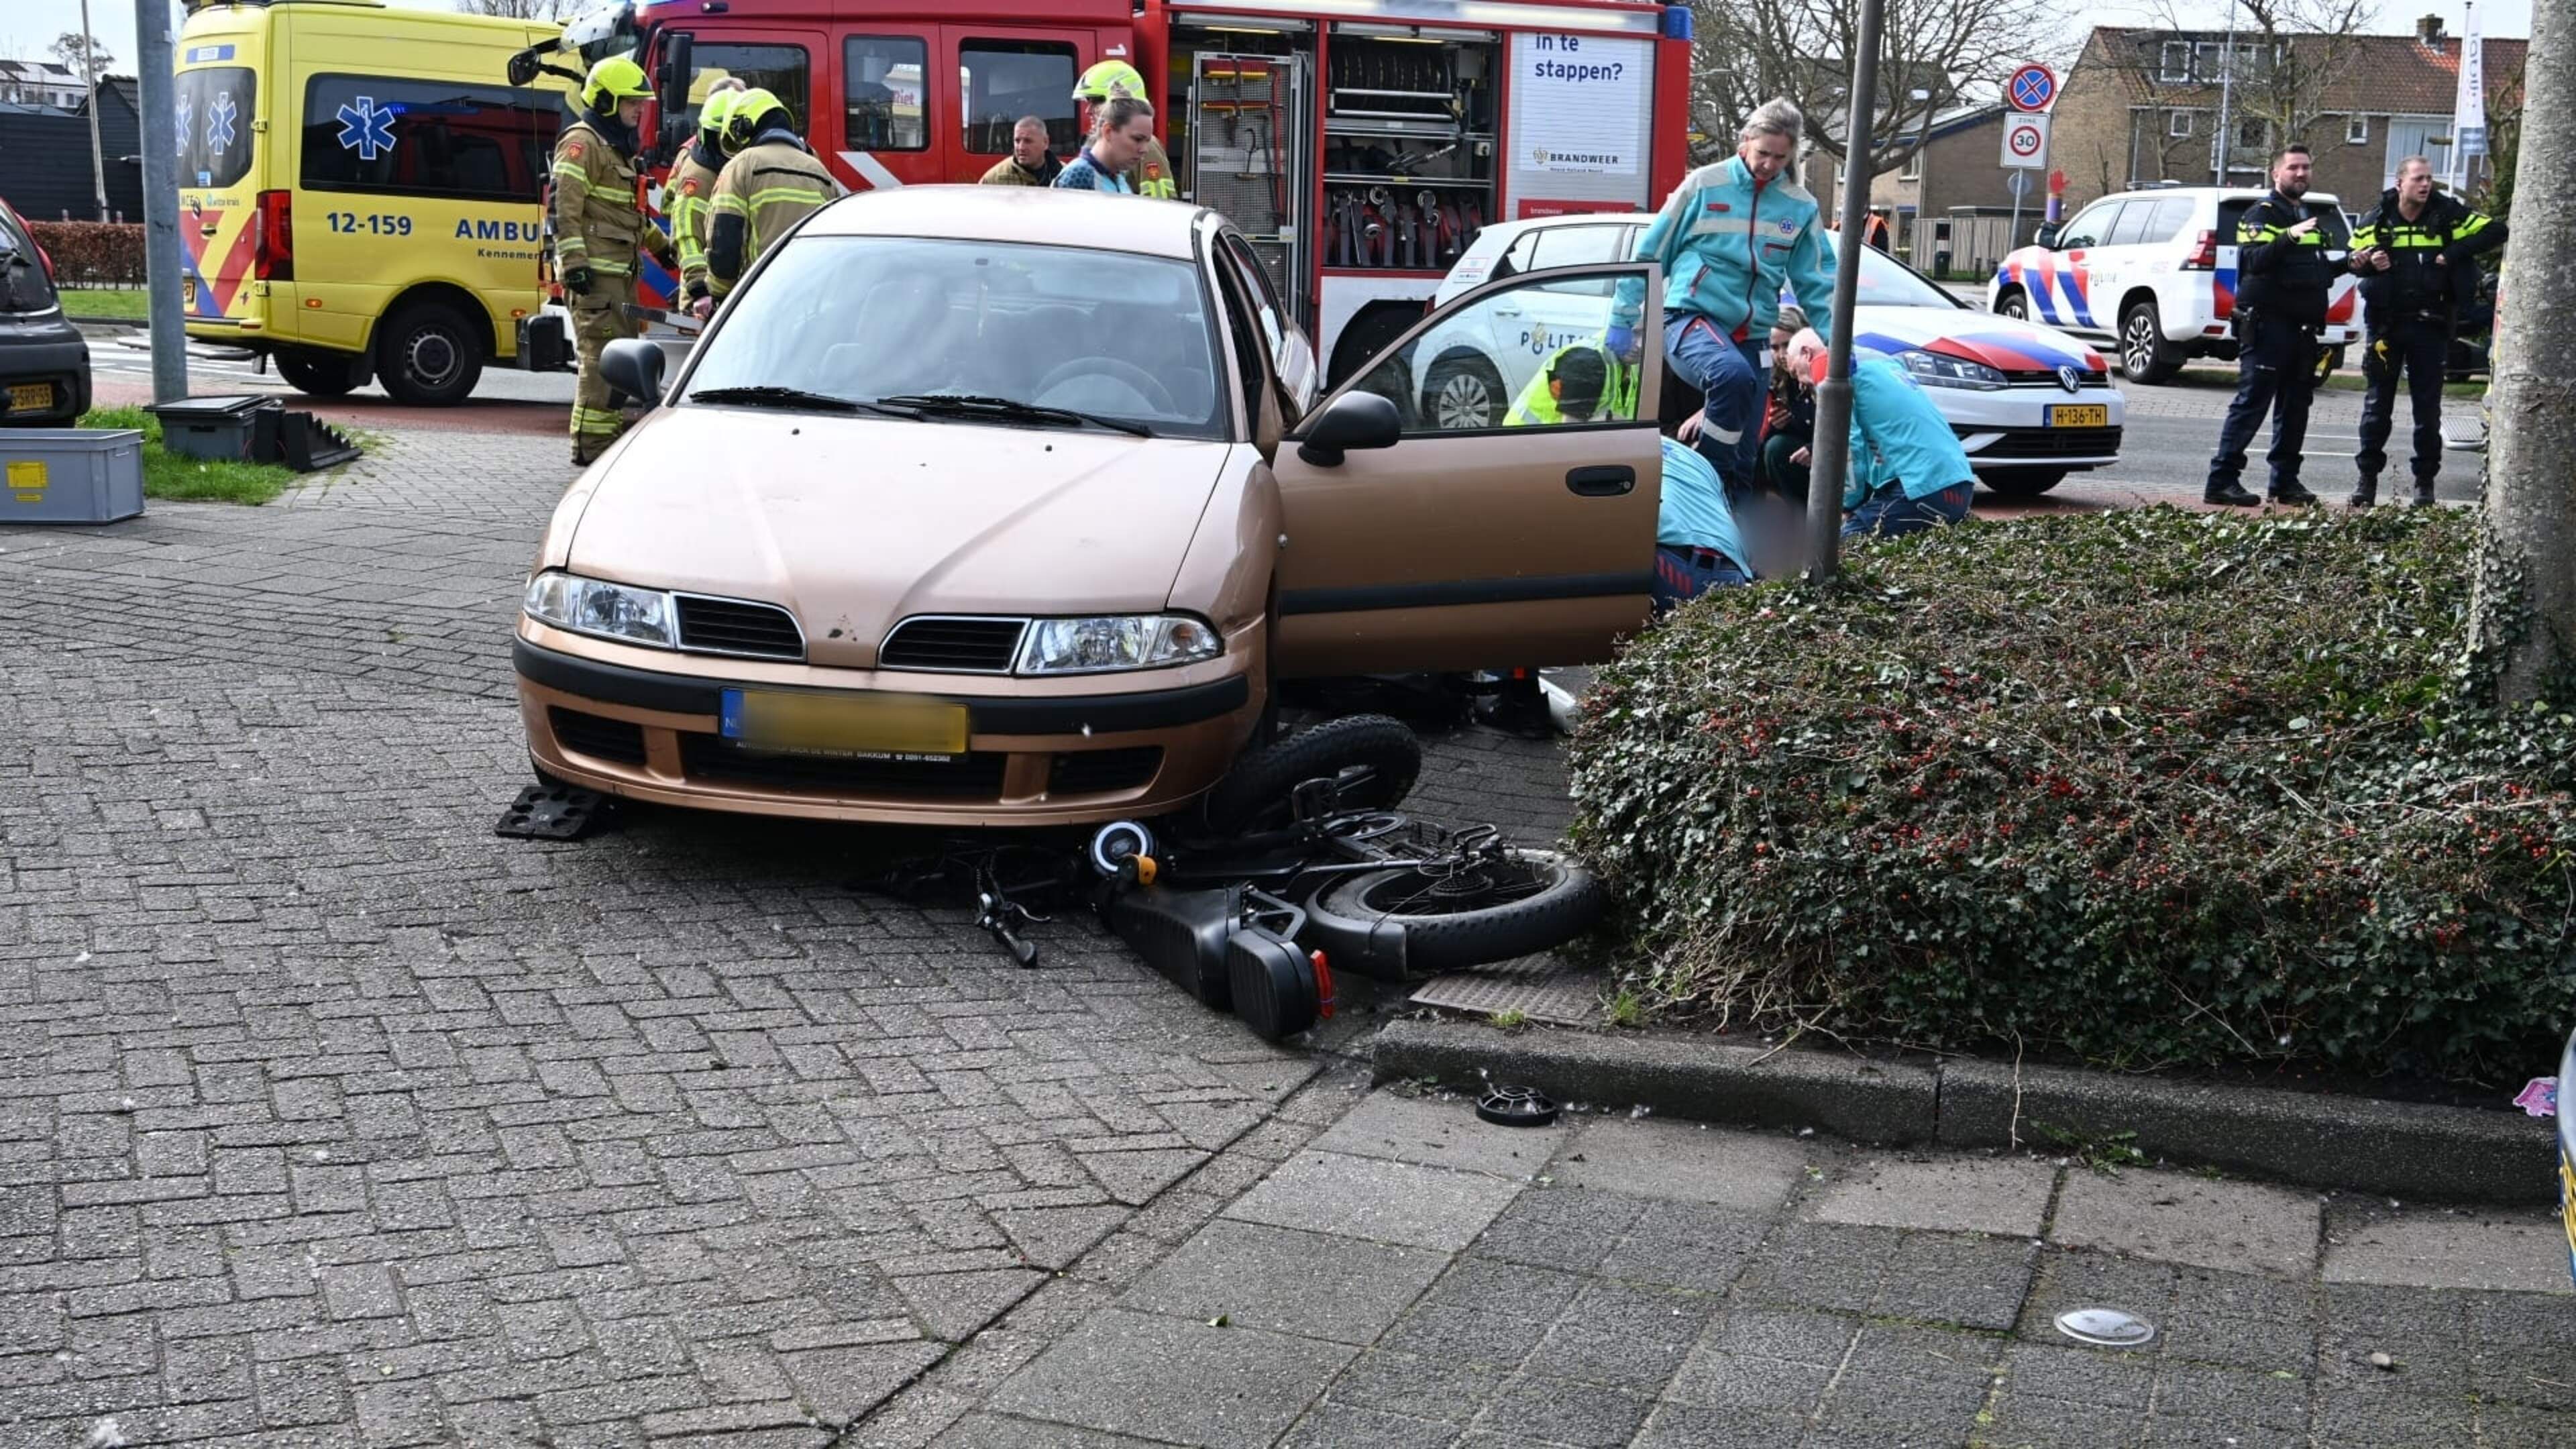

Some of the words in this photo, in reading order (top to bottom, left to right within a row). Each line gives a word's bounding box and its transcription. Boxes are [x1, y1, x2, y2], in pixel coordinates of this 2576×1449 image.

[1536, 32, 1554, 50] in
[1560, 34, 1579, 51] te
[1535, 59, 1623, 82] stappen?
[2017, 135, 2035, 146] 30
[1550, 154, 1619, 164] BRANDWEER
[327, 212, 412, 236] 12-159
[2055, 408, 2102, 424] H-136-TH
